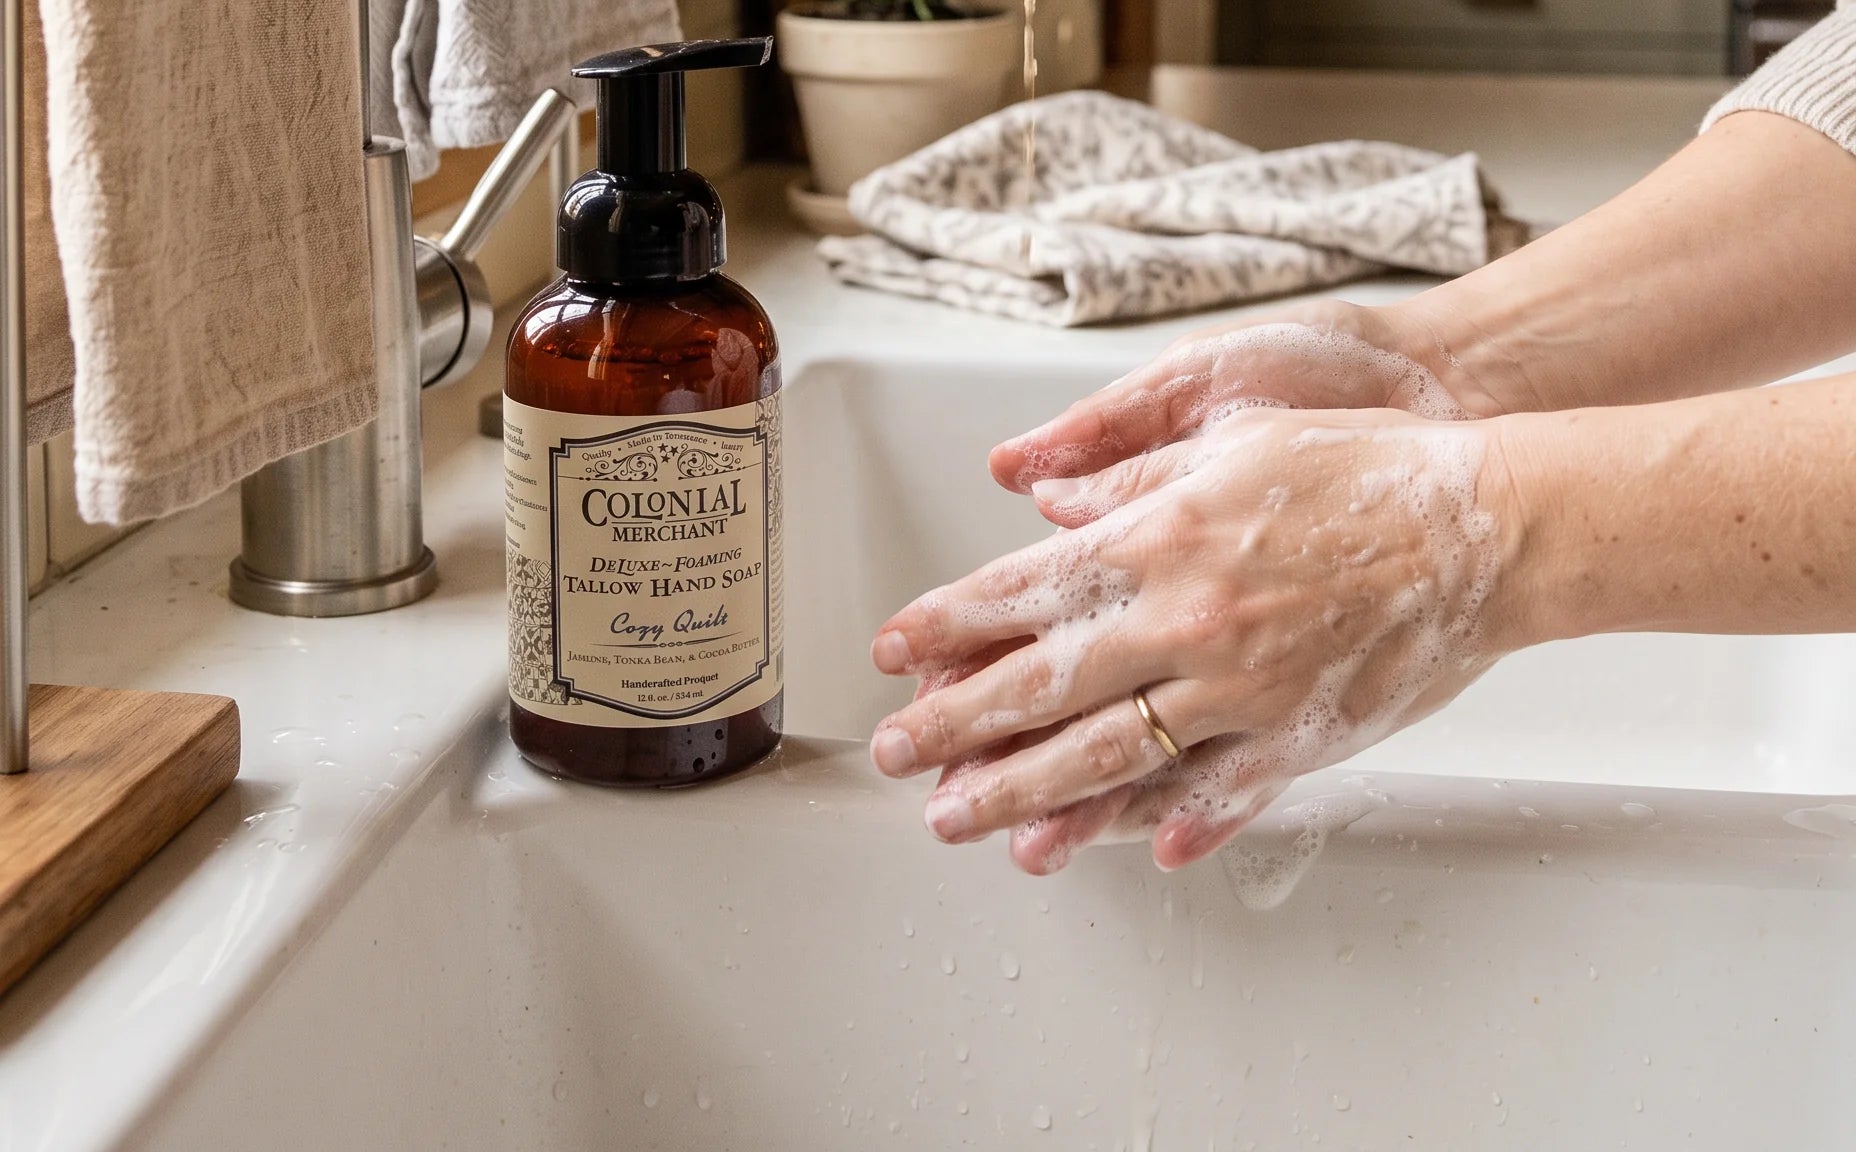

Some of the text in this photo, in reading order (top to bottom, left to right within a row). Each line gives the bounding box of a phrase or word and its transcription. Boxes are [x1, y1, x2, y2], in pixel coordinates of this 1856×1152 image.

[582, 479, 746, 527] COLONIAL
[612, 519, 728, 542] MERCHANT
[563, 562, 762, 598] TALLOW HAND SOAP
[610, 612, 664, 642] Cozy
[614, 655, 651, 665] TONKA
[698, 647, 731, 660] COCOA
